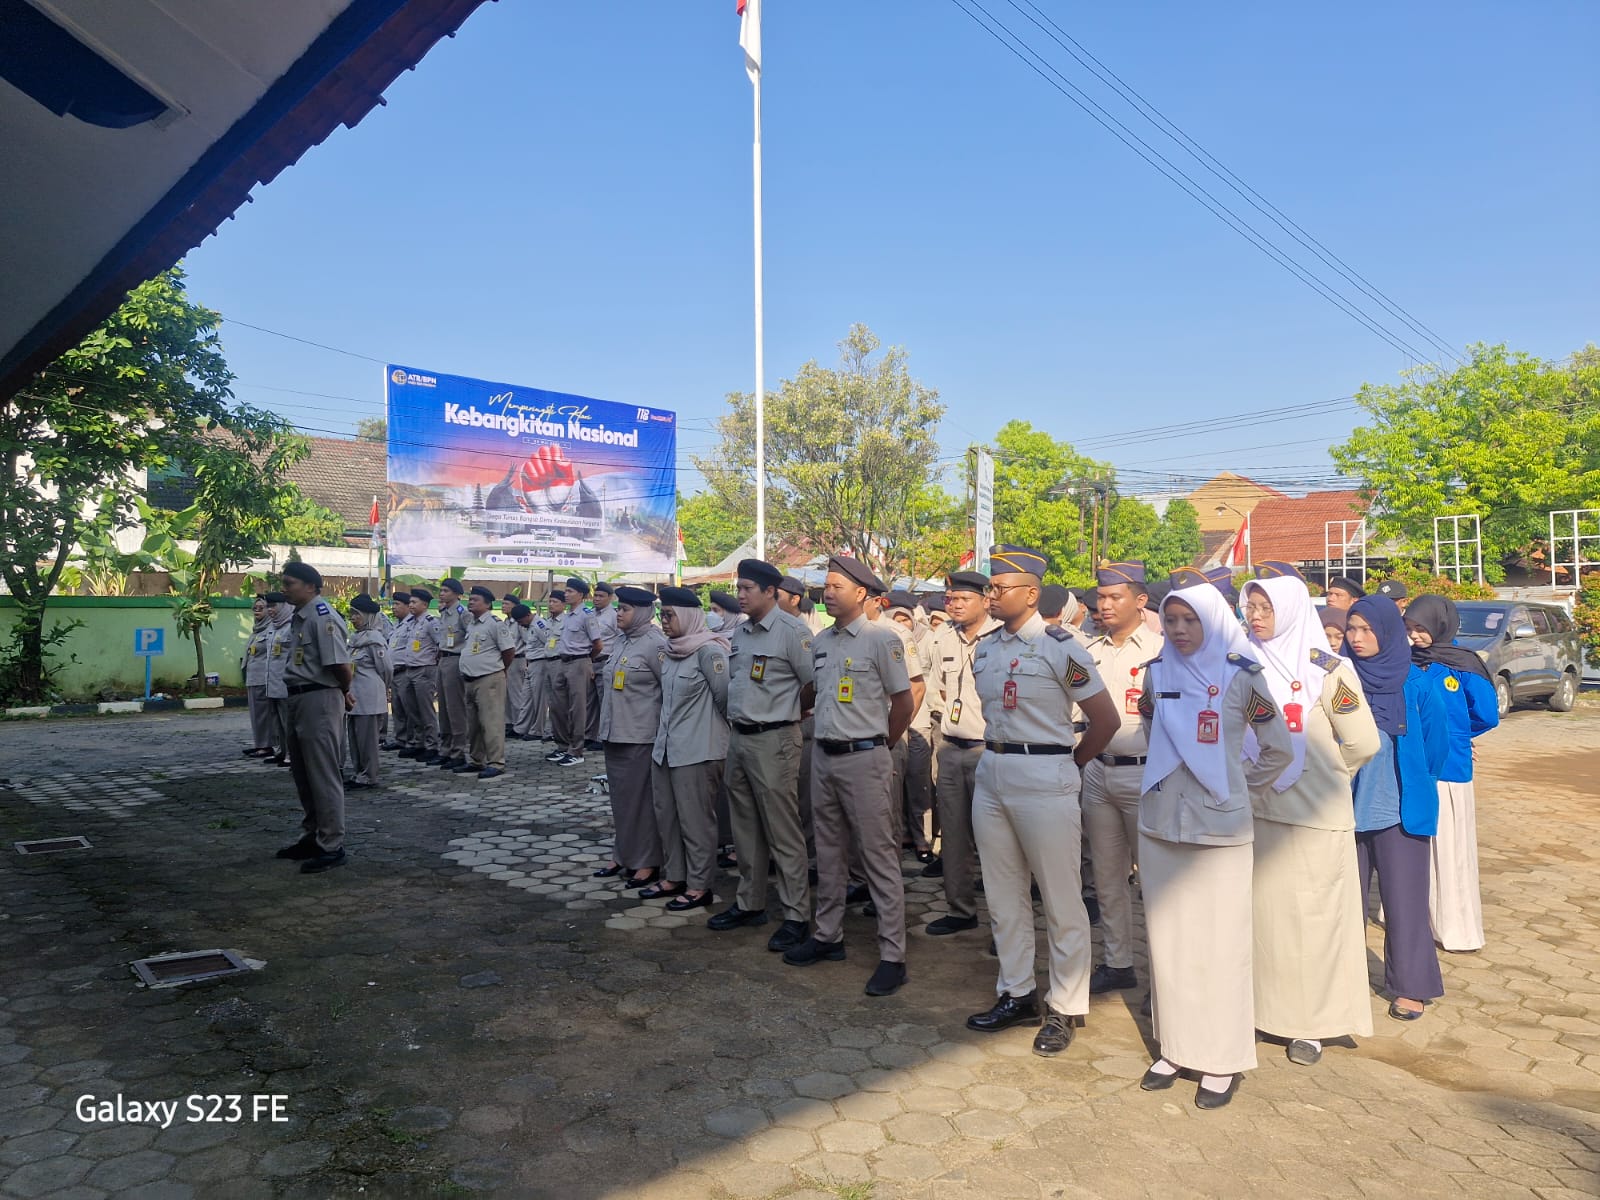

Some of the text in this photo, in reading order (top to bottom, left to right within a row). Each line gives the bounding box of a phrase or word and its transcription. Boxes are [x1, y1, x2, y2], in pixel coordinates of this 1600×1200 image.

[558, 405, 592, 422] Hari
[444, 402, 638, 448] Kebangkitan Nasional
[141, 630, 158, 650] P
